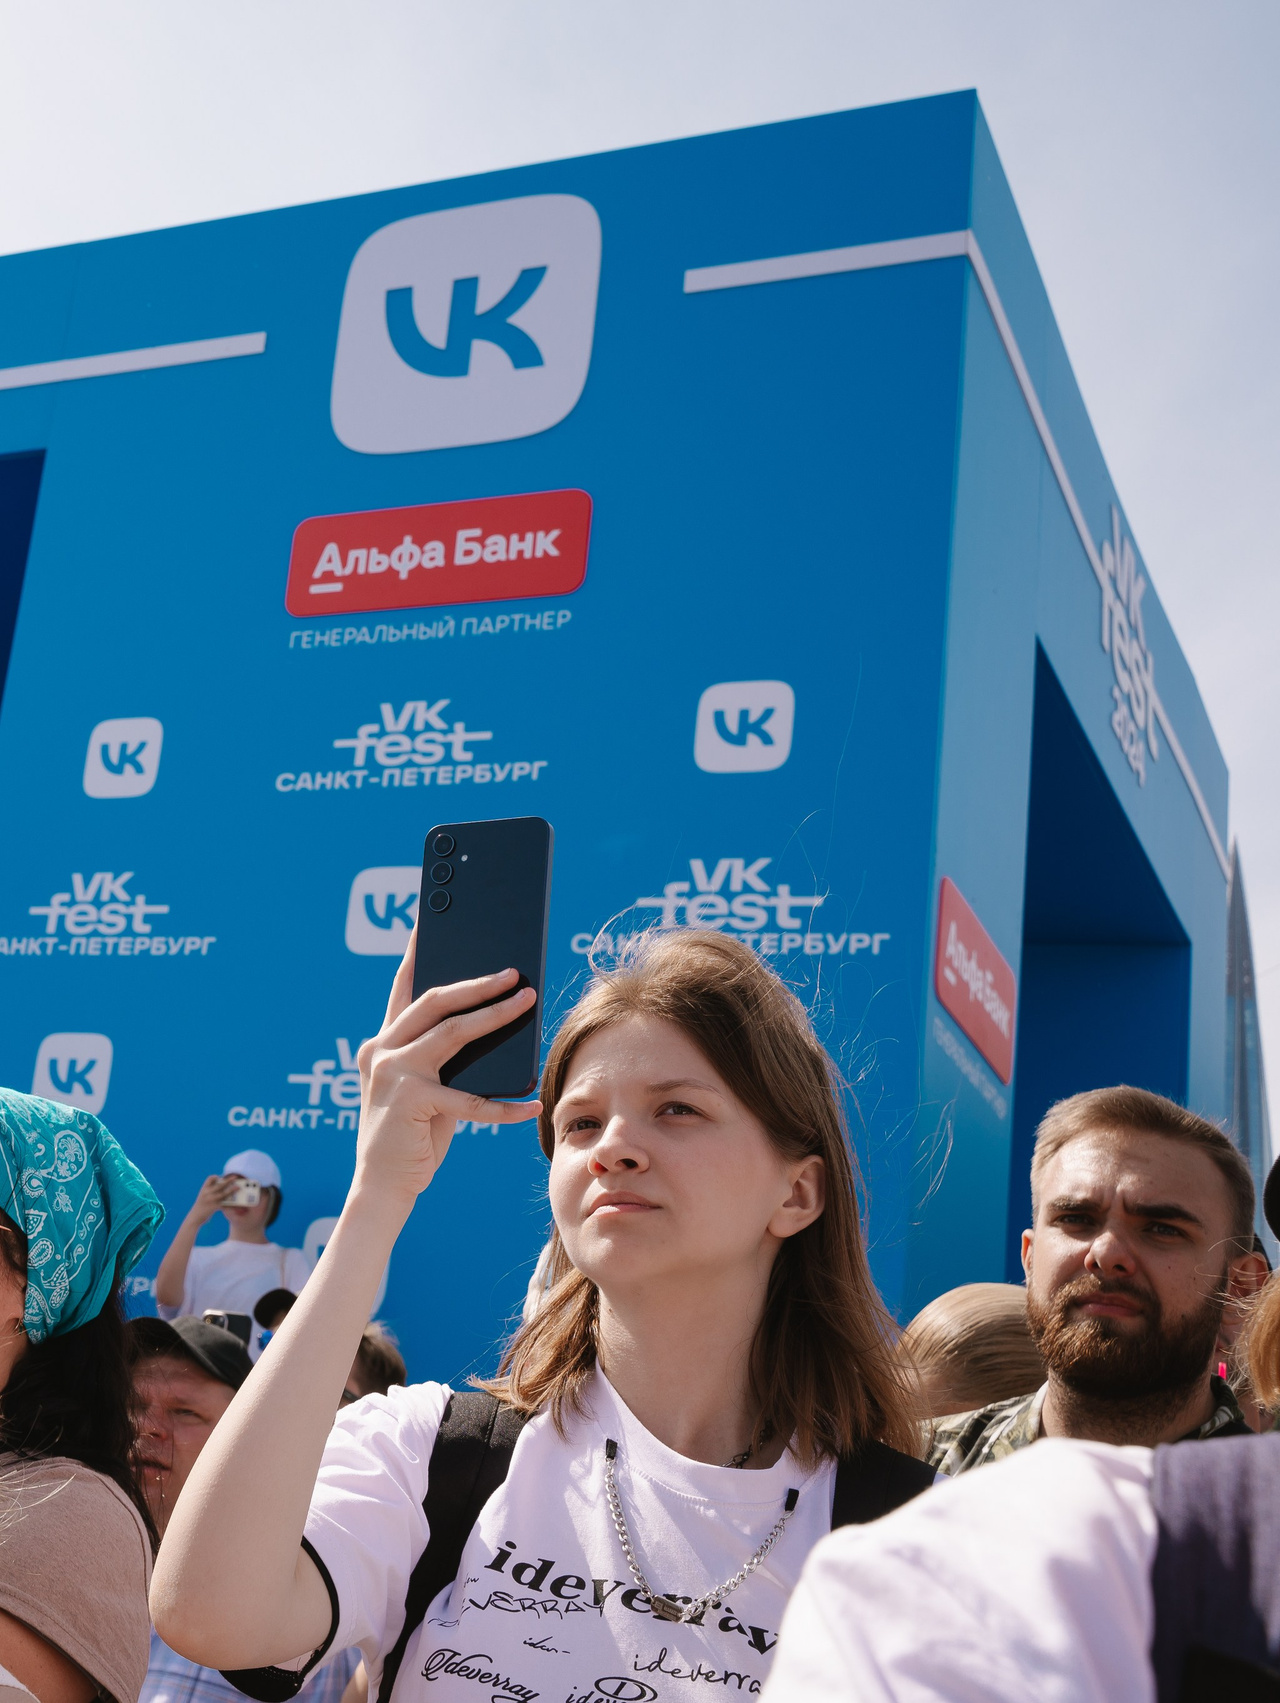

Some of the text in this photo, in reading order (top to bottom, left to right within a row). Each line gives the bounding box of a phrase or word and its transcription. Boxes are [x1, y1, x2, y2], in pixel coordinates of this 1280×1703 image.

[385, 265, 548, 378] VK
[309, 527, 561, 594] Альфа Банк
[1111, 503, 1147, 656] VK
[287, 609, 573, 650] ГЕНЕРАЛЬНЫЙ ПАРТНЕР
[379, 699, 451, 731] VK
[713, 707, 776, 748] VK
[100, 741, 147, 776] VK
[333, 720, 493, 767] fest
[275, 761, 548, 792] САНКТ-ПЕТЕРБУРГ
[71, 872, 135, 902] VK
[689, 857, 773, 892] VK
[28, 893, 170, 935] fest
[361, 893, 419, 931] VK
[636, 881, 825, 930] fest
[984, 970, 1011, 1040] Банк
[47, 1057, 97, 1096] VK
[287, 1059, 361, 1107] fe
[634, 1647, 762, 1695] ideverra
